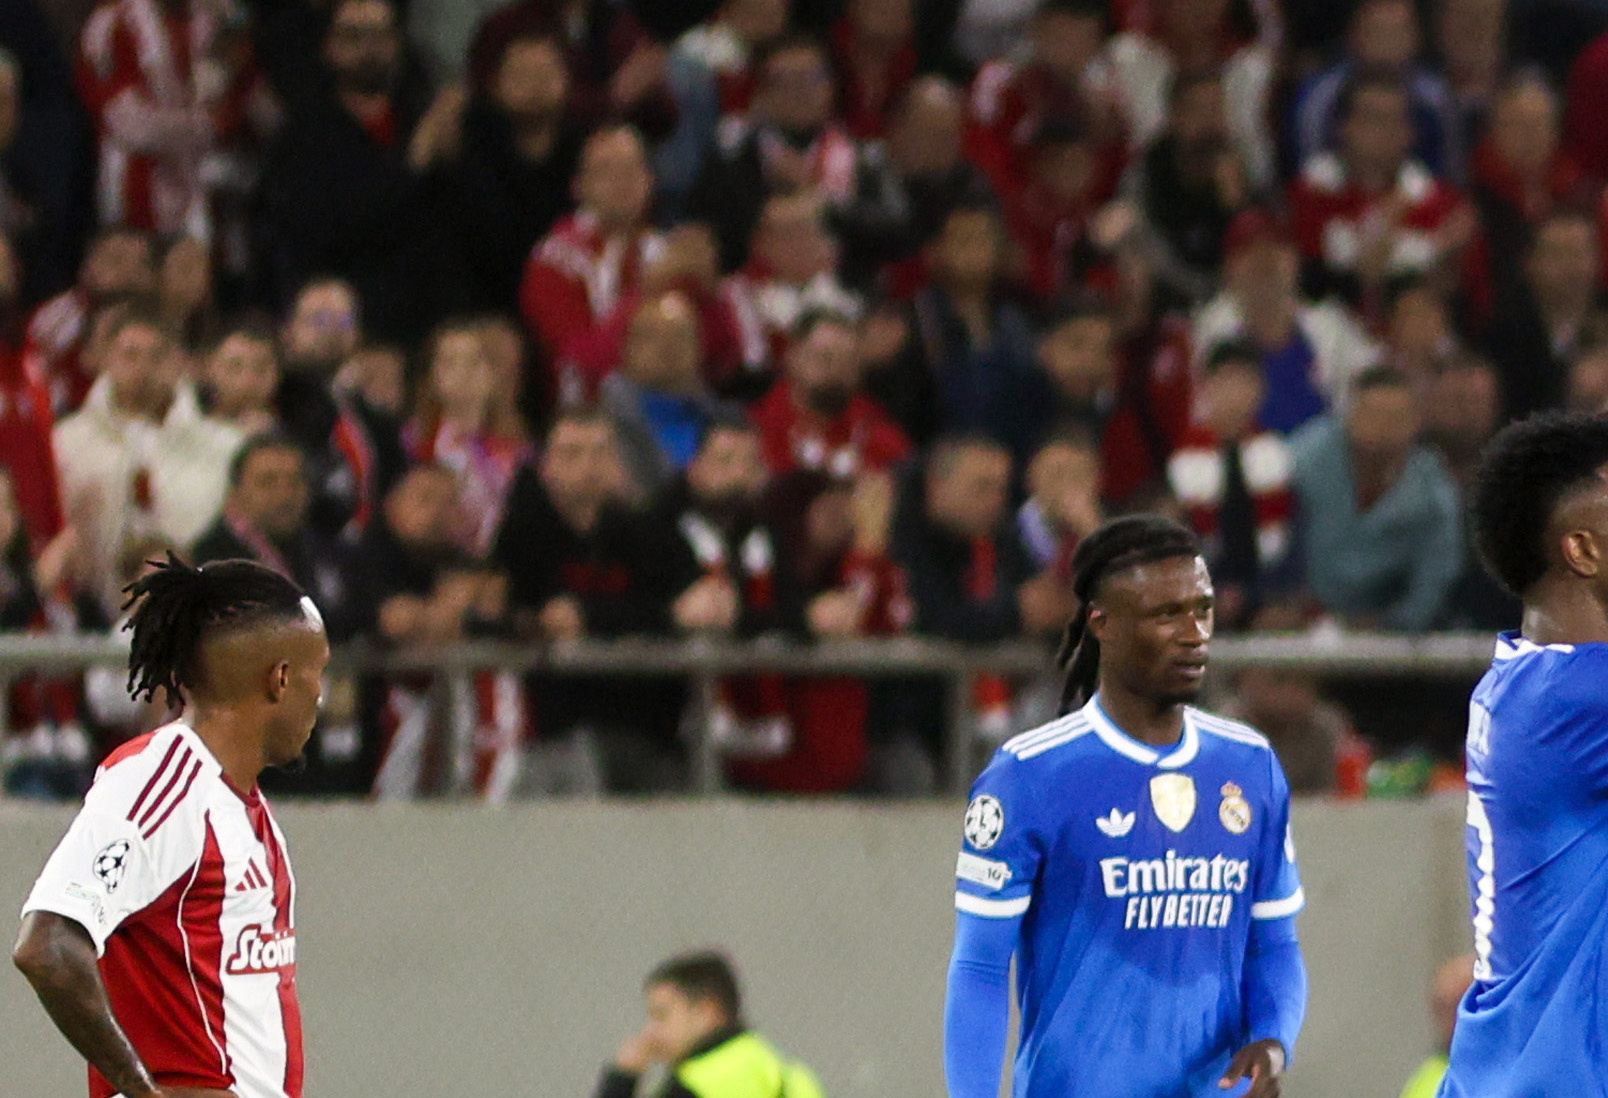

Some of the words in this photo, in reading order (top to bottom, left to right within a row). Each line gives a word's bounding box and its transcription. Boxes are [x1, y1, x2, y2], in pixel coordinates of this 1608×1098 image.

[1099, 849, 1249, 898] Emirates
[1124, 895, 1164, 930] FLY
[1162, 893, 1234, 929] BETTER
